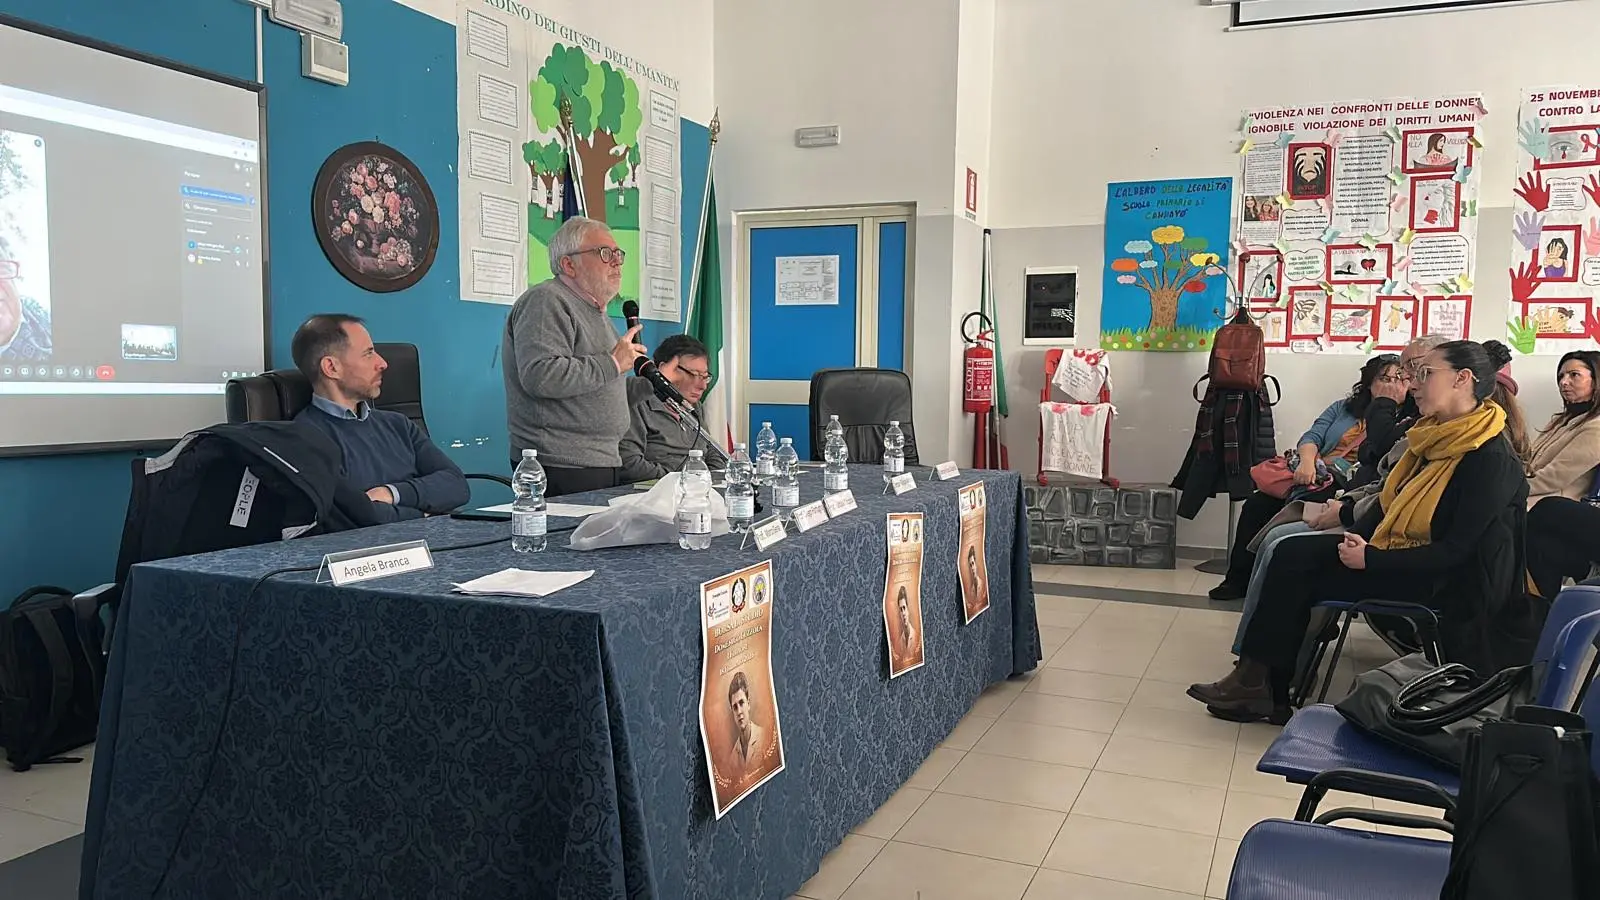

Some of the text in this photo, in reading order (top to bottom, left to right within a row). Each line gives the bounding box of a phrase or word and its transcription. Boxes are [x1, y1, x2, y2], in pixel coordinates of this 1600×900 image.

[535, 12, 557, 35] DEI
[559, 25, 602, 54] GIUSTI
[604, 47, 633, 71] DELL'
[1530, 93, 1544, 103] 25
[1307, 107, 1324, 116] NEI
[1331, 102, 1393, 115] CONFRONTI
[1396, 101, 1429, 111] DELLE
[1539, 105, 1584, 117] CONTRO
[1248, 113, 1475, 134] IGNOBILE VIOLAZIONE DEI DIRITTI UMANI
[344, 555, 410, 578] Angela Branca
